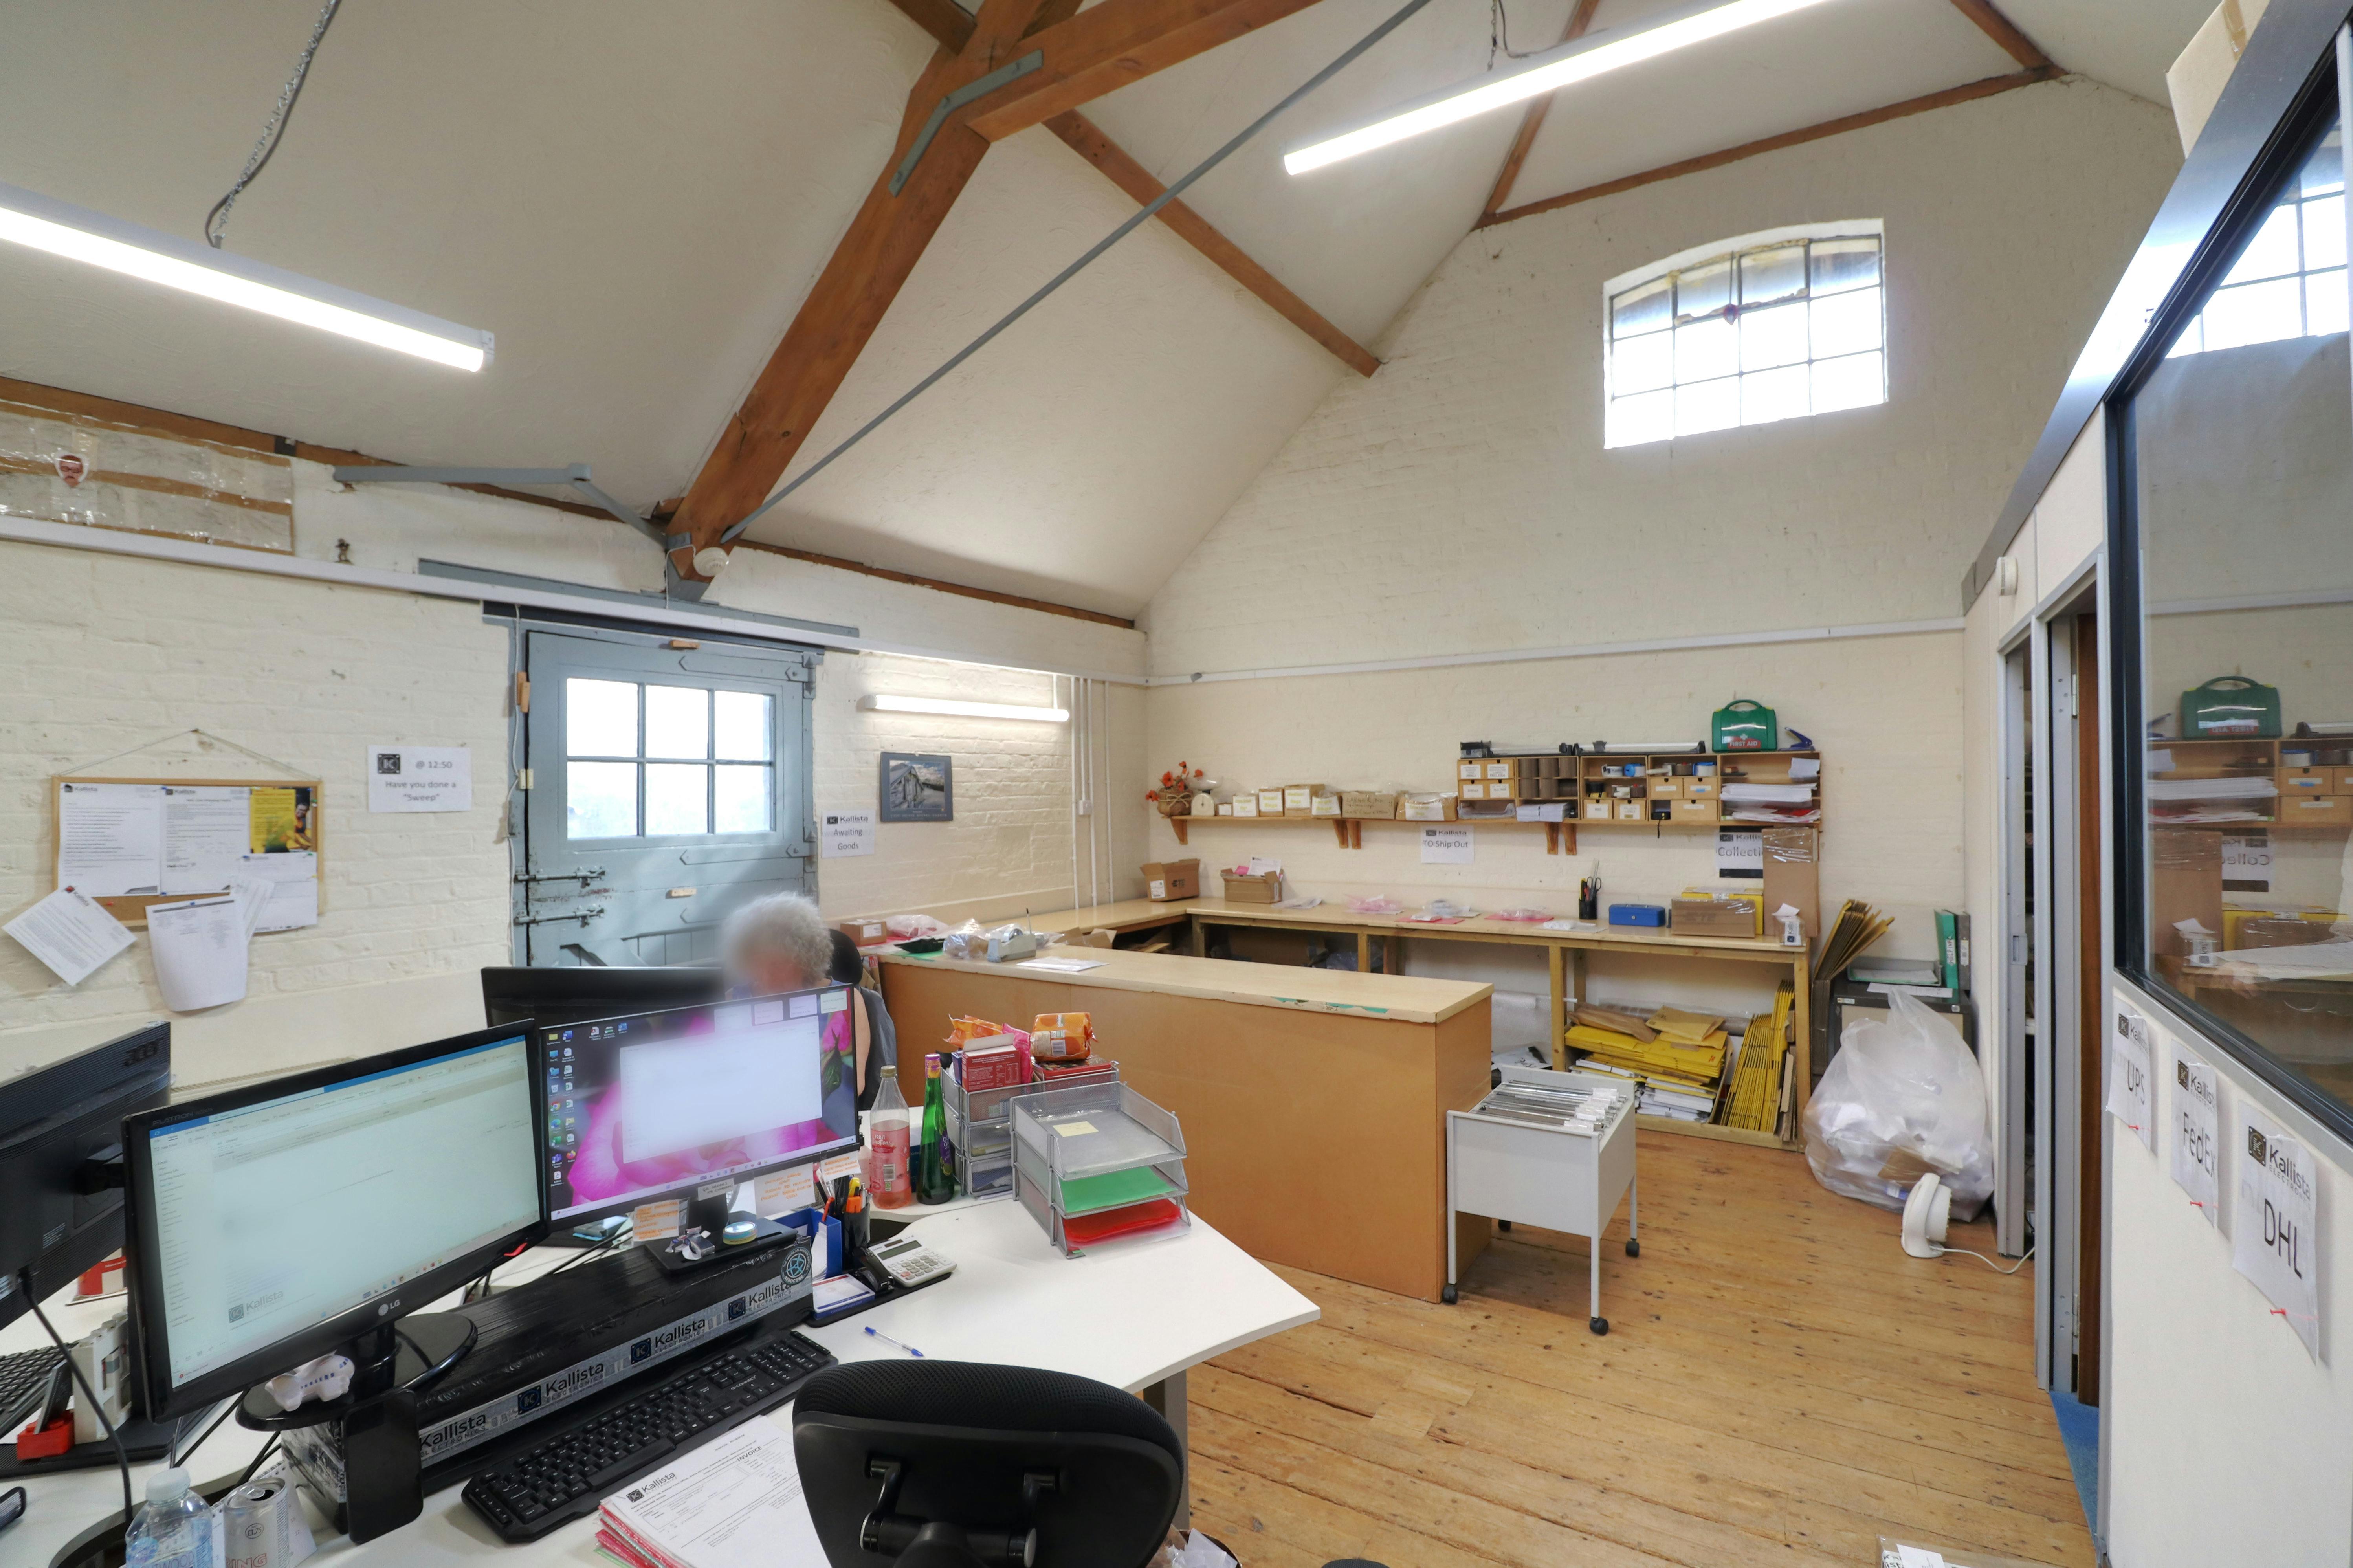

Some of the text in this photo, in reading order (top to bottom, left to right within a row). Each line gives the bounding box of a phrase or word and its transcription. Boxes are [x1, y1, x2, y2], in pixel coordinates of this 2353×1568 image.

[415, 760, 425, 769] @
[834, 828, 862, 836] Awaiting
[1436, 840, 1451, 849] Ship
[2127, 1060, 2146, 1105] UPS
[152, 1111, 194, 1126] FLATRON
[2183, 1111, 2215, 1183] FedEx
[2269, 1144, 2311, 1201] Kallista
[2264, 1198, 2303, 1280] DHL
[246, 1290, 284, 1311] Kallista
[389, 1298, 401, 1309] LG
[655, 1319, 705, 1348] Kallista
[546, 1363, 604, 1396] Kallista
[420, 1414, 486, 1451] Kallista
[736, 1445, 763, 1462] INVOICE
[642, 1472, 676, 1493] Kallista
